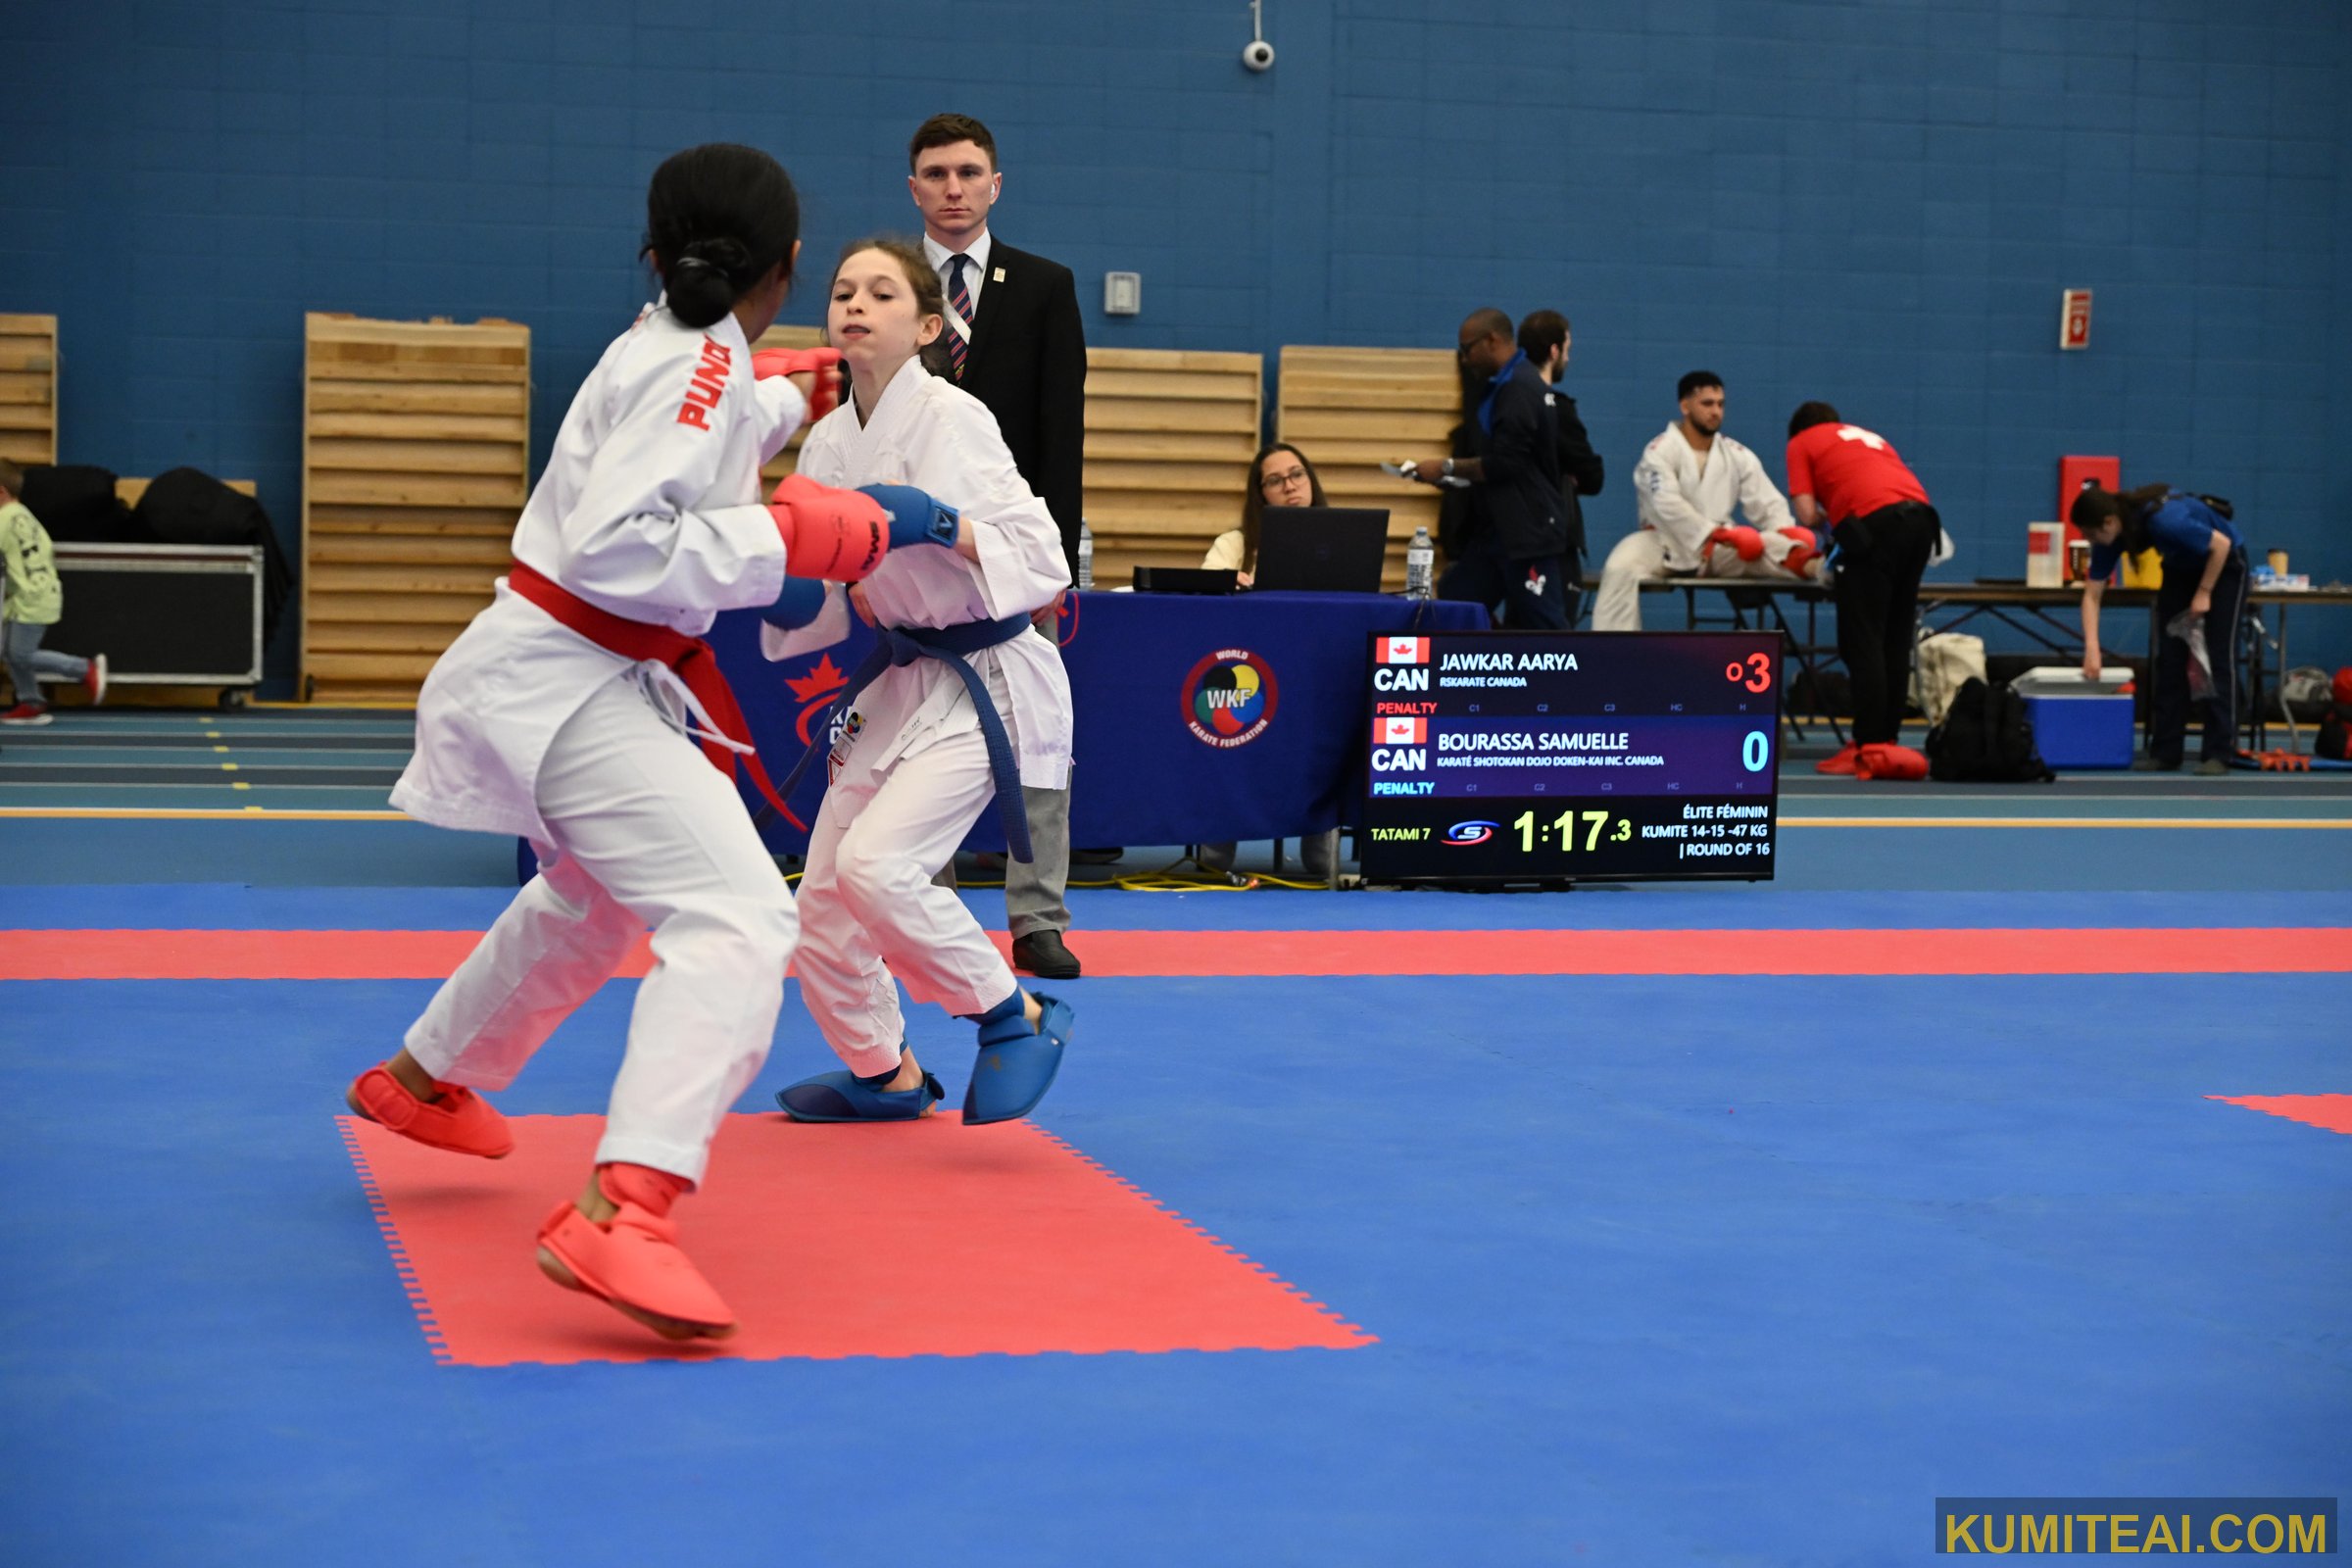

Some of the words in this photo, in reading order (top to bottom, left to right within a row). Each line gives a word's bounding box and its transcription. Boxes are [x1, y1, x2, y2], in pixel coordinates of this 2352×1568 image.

[1215, 649, 1249, 661] WORLD
[1440, 654, 1514, 670] JAWKAR
[1517, 654, 1578, 670] AARYA
[1374, 668, 1429, 691] CAN
[1440, 677, 1486, 687] RSKARATE
[1487, 677, 1527, 687] CANADA
[1206, 689, 1251, 709] WKF
[1376, 702, 1438, 714] PENALTY
[1469, 704, 1480, 712] C1
[1537, 704, 1548, 712] C2
[1604, 704, 1616, 712] C3
[1188, 720, 1218, 747] KARATE
[1219, 718, 1268, 748] FEDERATION
[1438, 733, 1535, 751] BOURASSA
[1538, 732, 1629, 751] SAMUELLE
[1742, 730, 1769, 772] 0
[1372, 748, 1427, 771] CAN
[1437, 755, 1472, 767] KARATÉ
[1473, 757, 1525, 766] SHOTOKAN
[1526, 757, 1552, 766] DOJO
[1553, 756, 1603, 766] DOKEN-KAI
[1604, 756, 1624, 765] INC.
[1624, 756, 1664, 765] CANADA
[1373, 782, 1435, 795] PENALTY
[1683, 804, 1714, 819] ÉLITE
[1716, 804, 1768, 818] FÉMININ
[1371, 828, 1419, 841] TATAMI
[1422, 828, 1431, 841] 7
[1642, 825, 1689, 838] KUMITE
[1691, 824, 1725, 837] 14-15
[1728, 824, 1747, 837] -47
[1749, 824, 1768, 837] KG
[1686, 843, 1734, 857] ROUND
[1735, 843, 1752, 856] OF
[1755, 842, 1770, 856] 16
